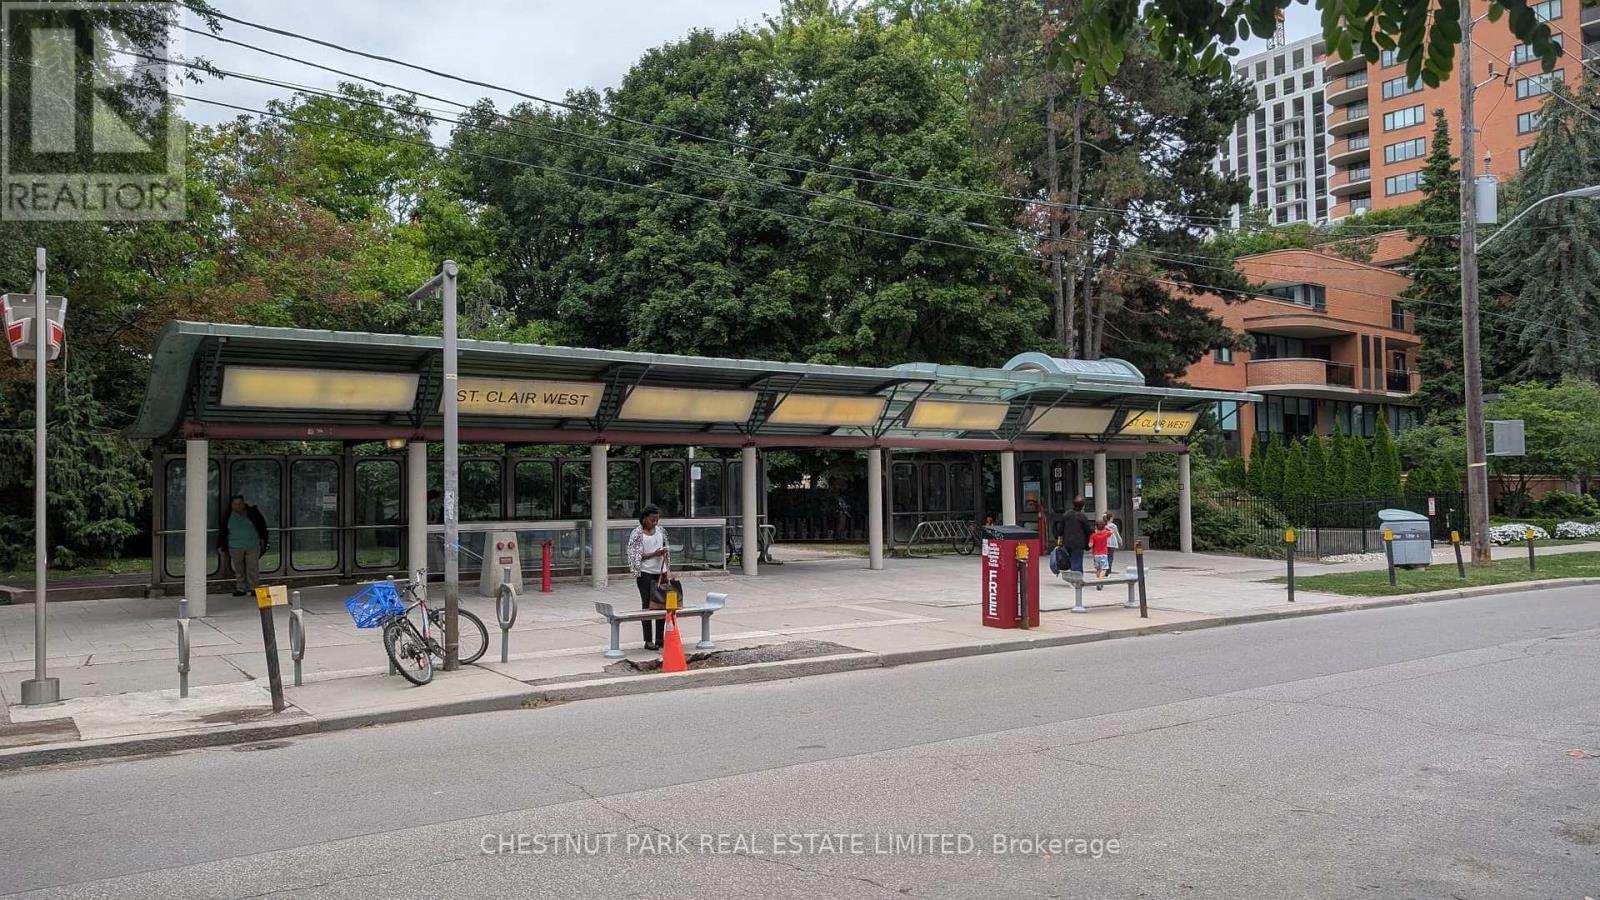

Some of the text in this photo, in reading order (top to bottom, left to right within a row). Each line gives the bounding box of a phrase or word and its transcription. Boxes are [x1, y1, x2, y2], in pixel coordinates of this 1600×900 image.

[456, 390, 589, 406] ST. CLAIR WEST
[1167, 420, 1190, 429] WEST
[989, 569, 998, 616] FREE
